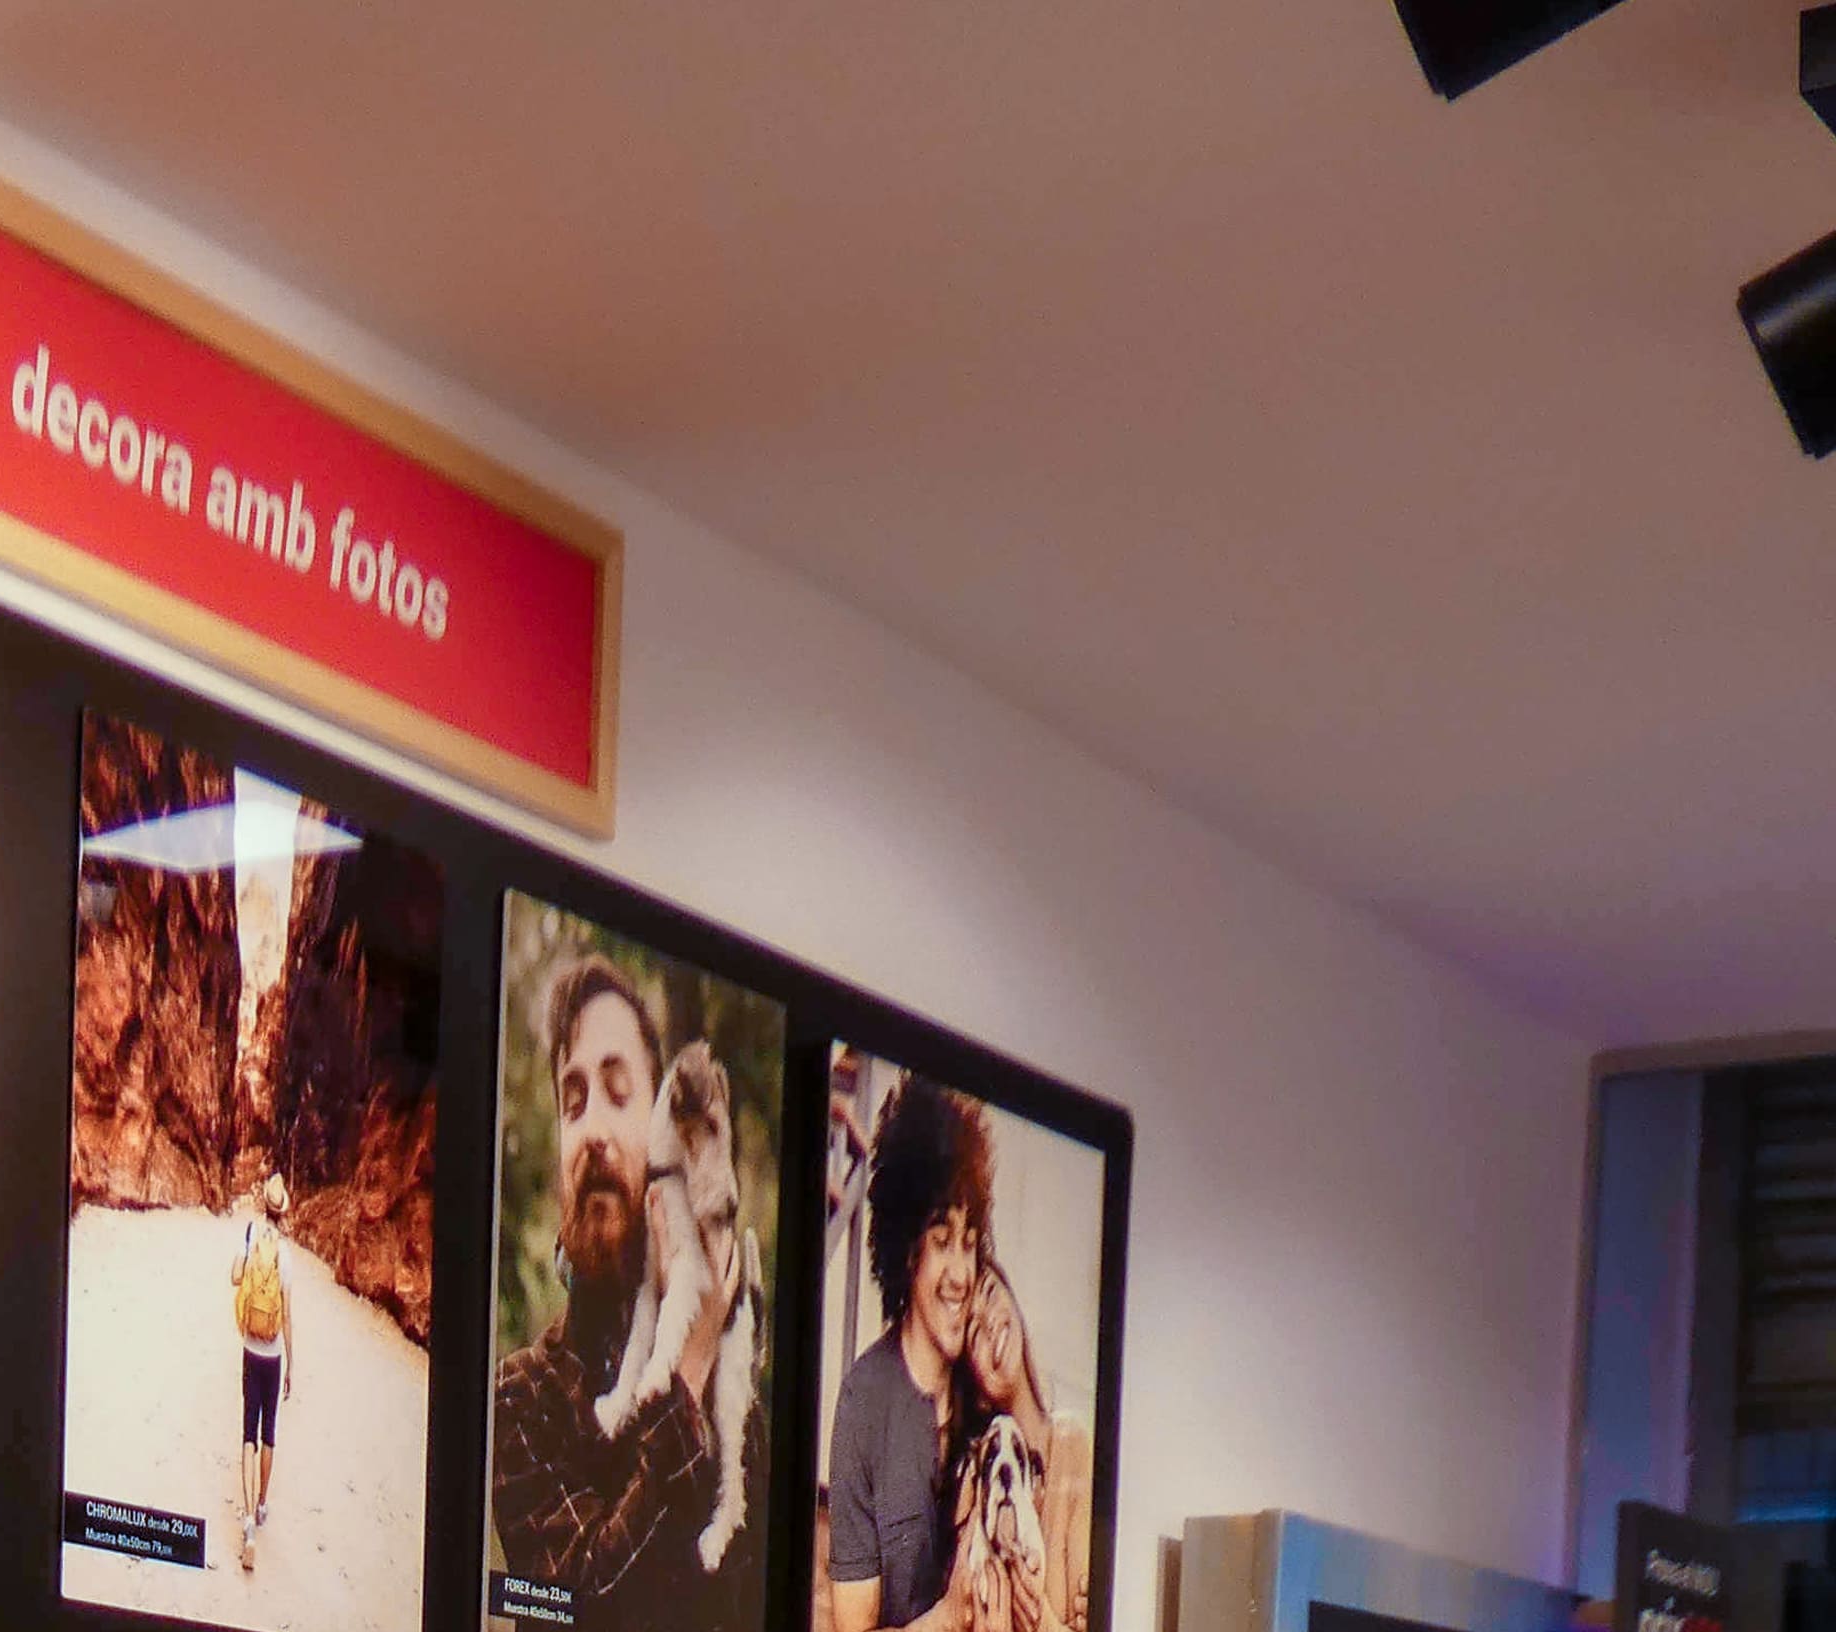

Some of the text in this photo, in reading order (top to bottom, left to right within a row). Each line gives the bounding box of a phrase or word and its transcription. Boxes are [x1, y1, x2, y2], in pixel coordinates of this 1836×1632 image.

[11, 344, 449, 642] decora amb fotos
[86, 1501, 146, 1527] CHROMALUX
[85, 1528, 116, 1544] Muestra
[504, 1577, 530, 1595] FOREX
